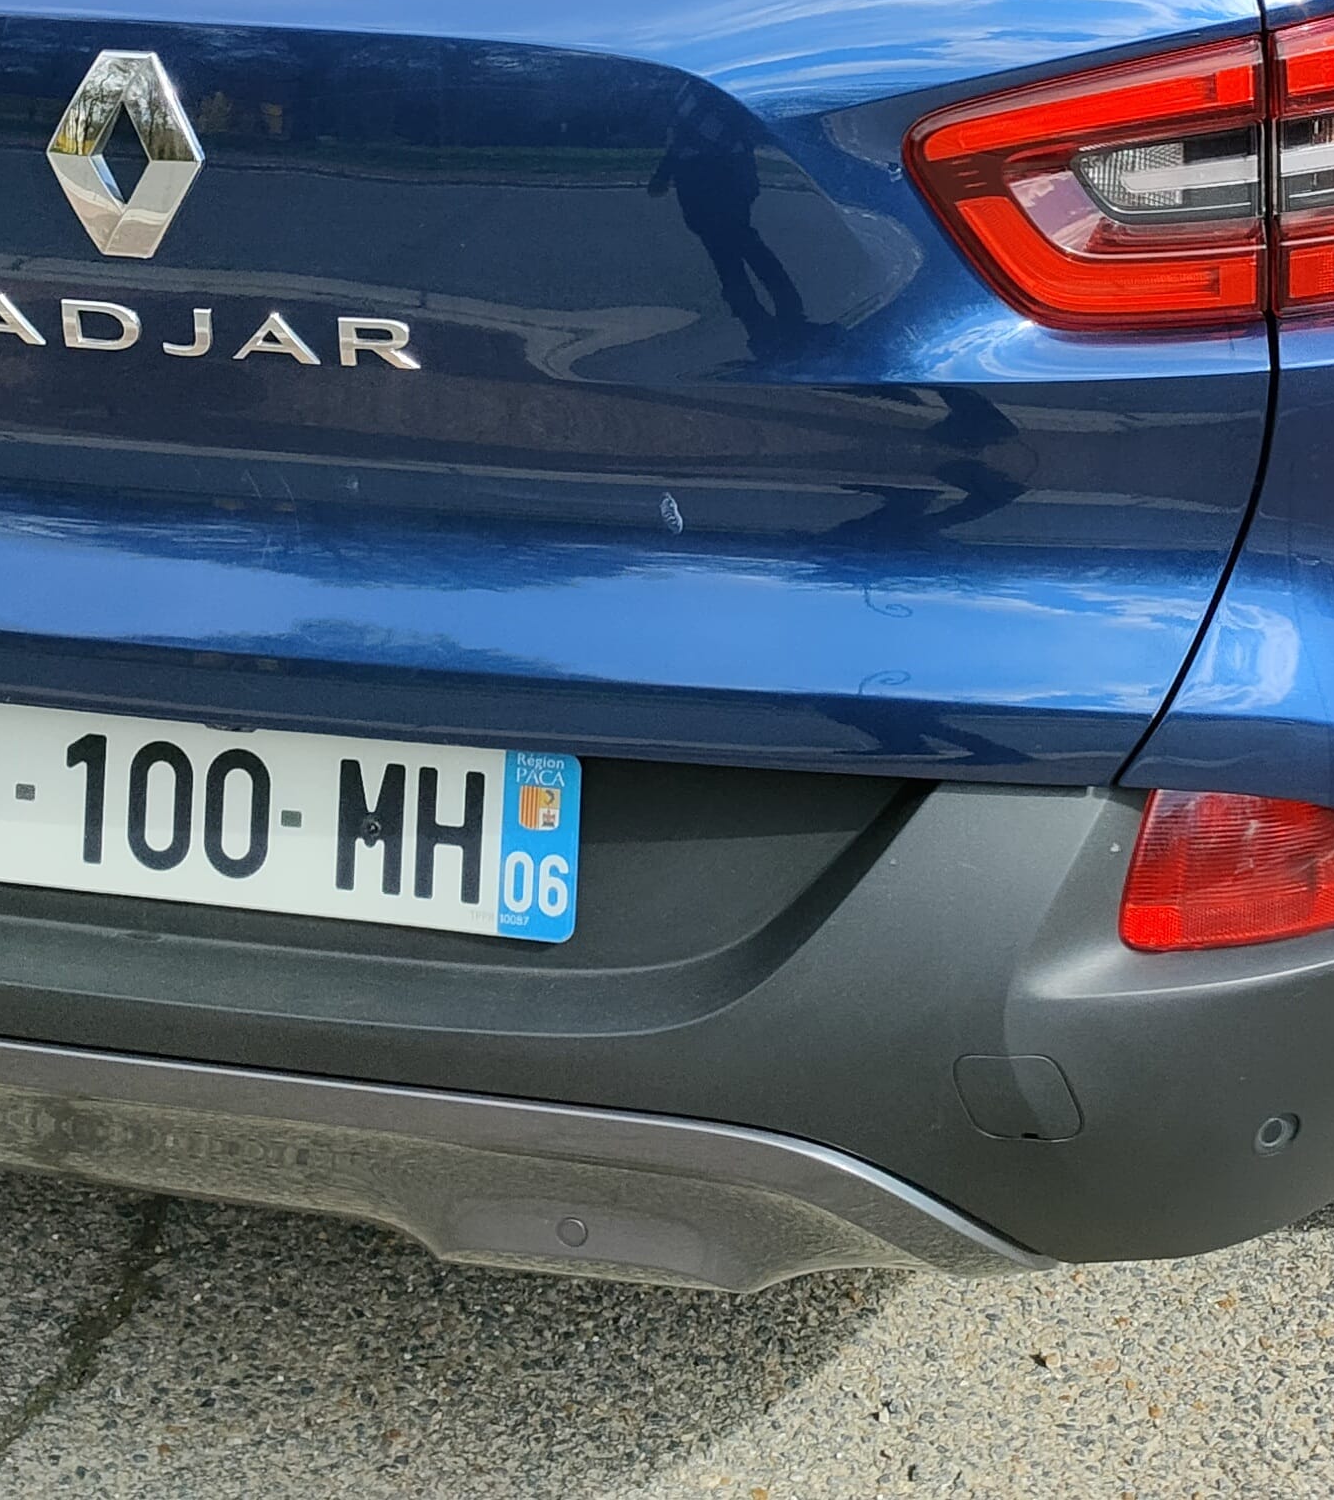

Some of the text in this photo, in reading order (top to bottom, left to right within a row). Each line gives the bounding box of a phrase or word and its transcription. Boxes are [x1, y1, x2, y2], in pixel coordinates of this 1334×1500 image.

[517, 752, 565, 771] Région
[515, 767, 566, 788] PACA
[503, 850, 570, 918] 06
